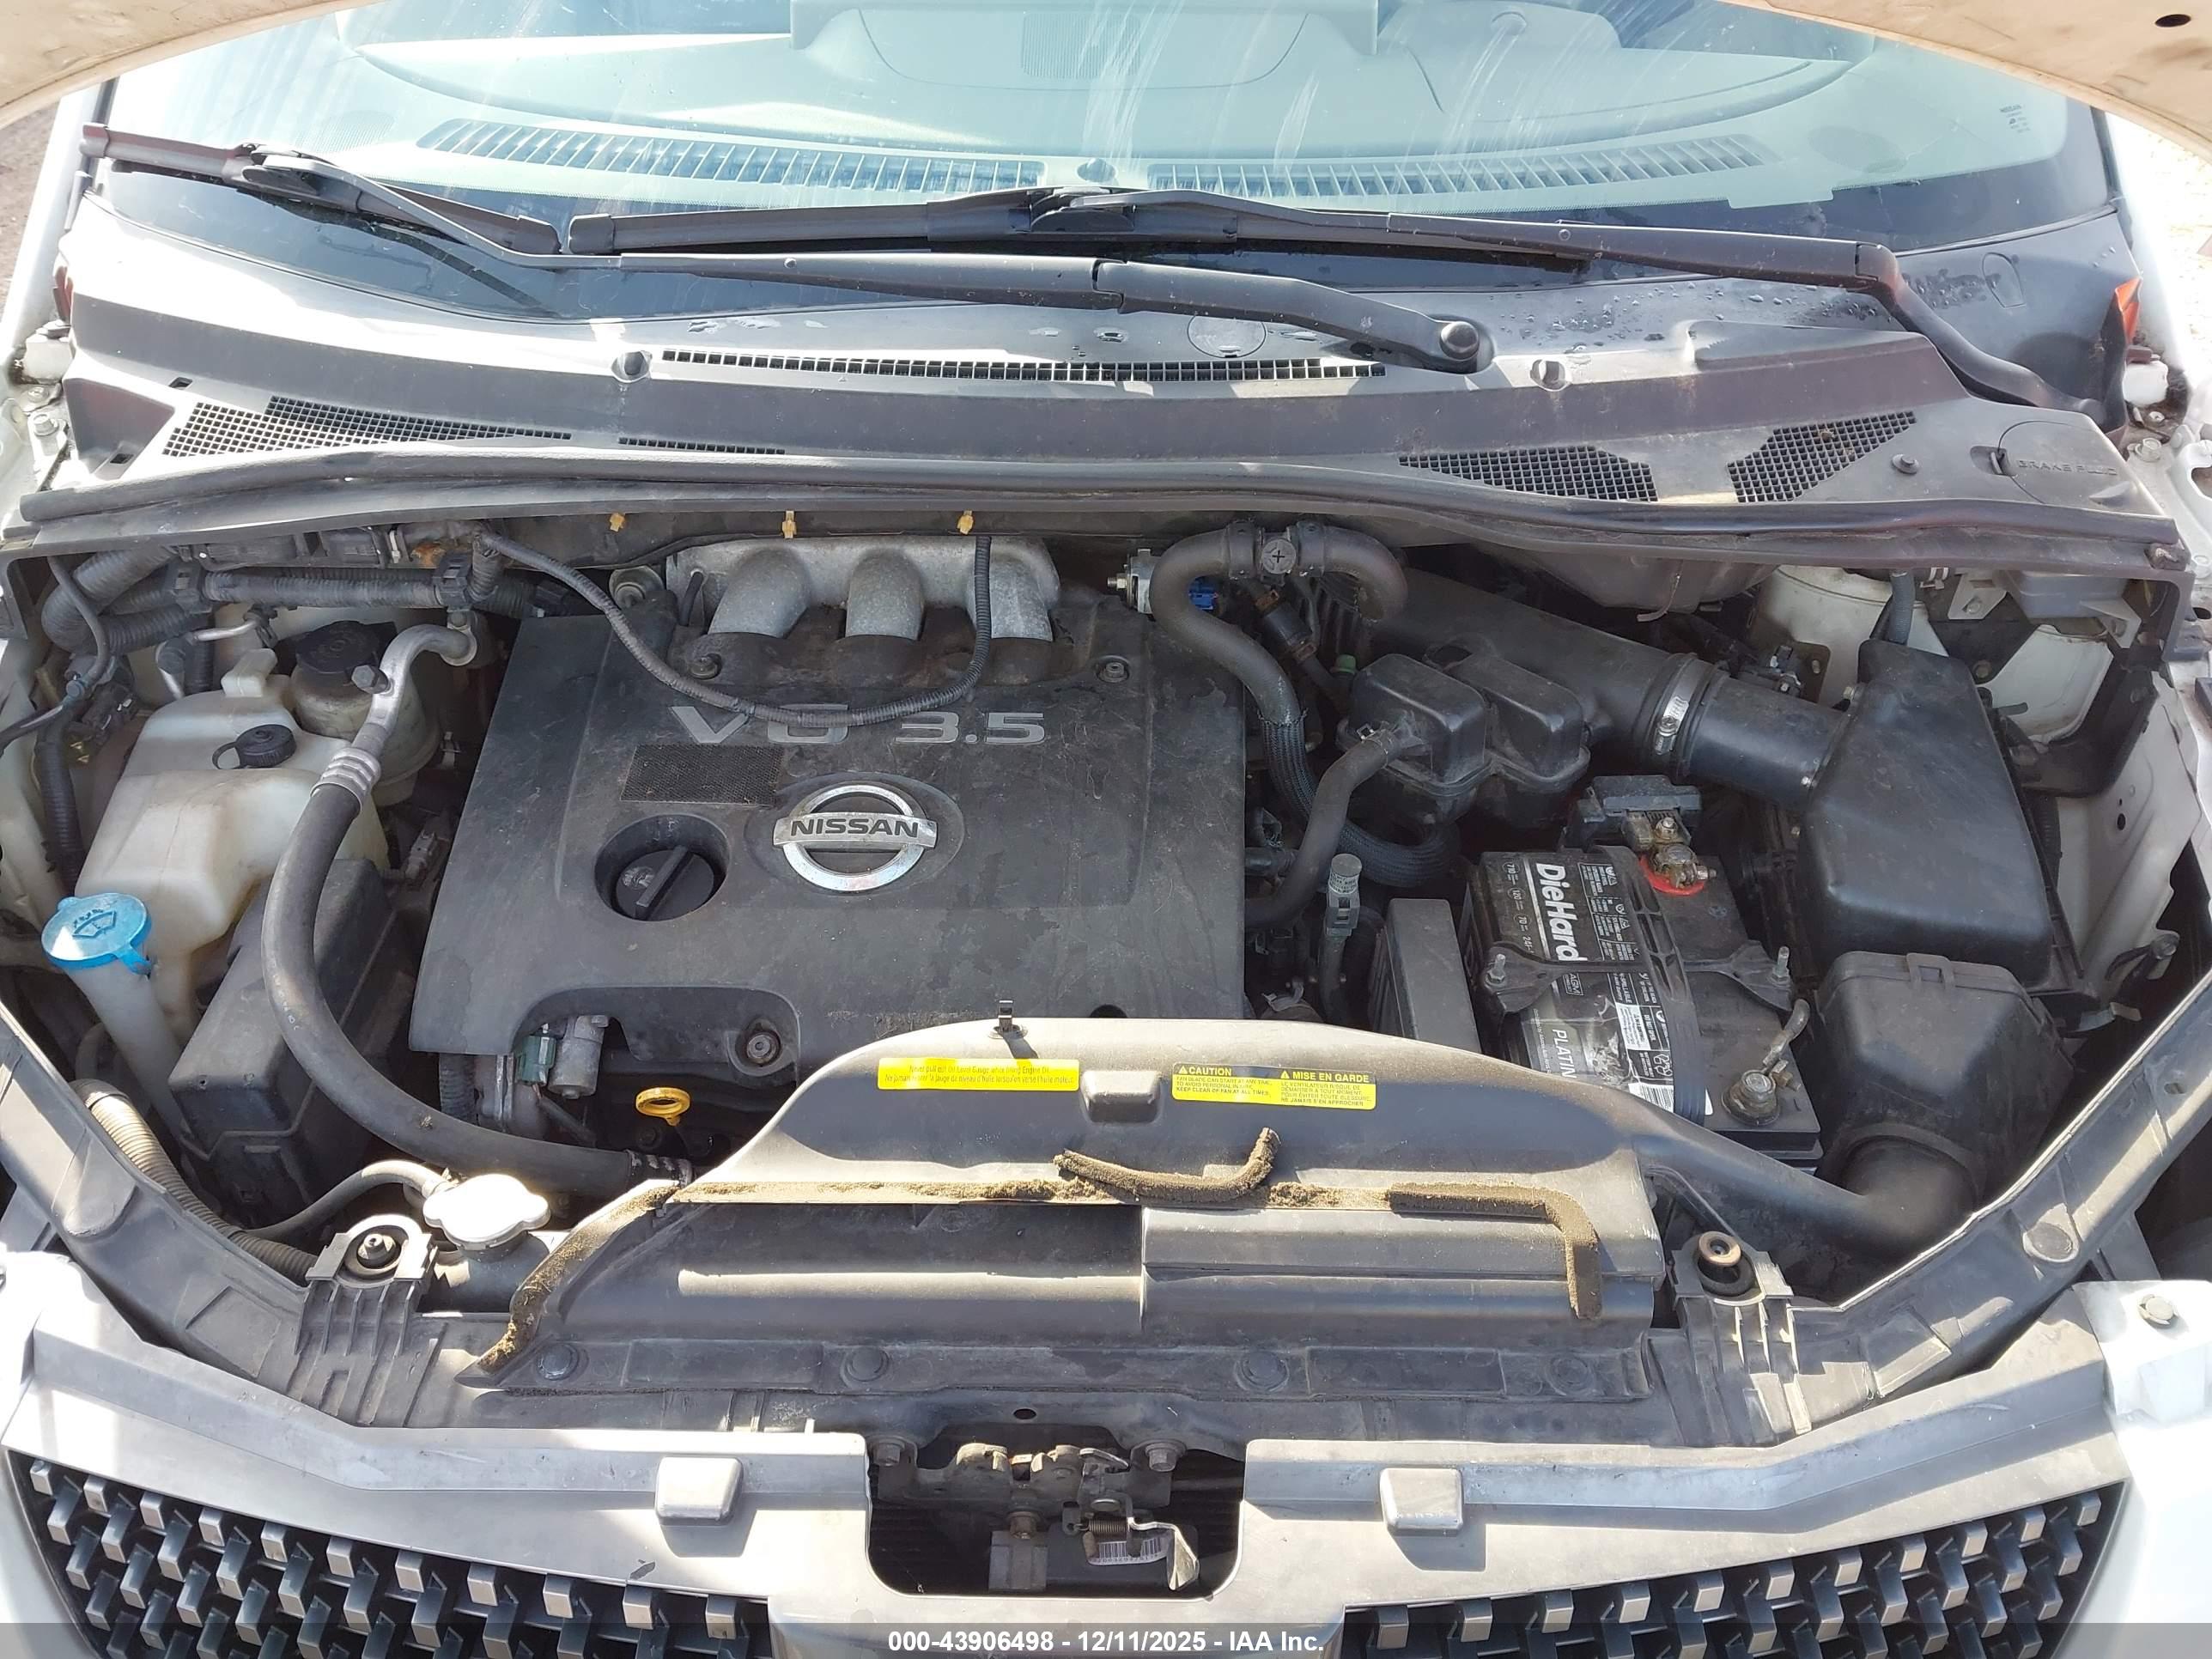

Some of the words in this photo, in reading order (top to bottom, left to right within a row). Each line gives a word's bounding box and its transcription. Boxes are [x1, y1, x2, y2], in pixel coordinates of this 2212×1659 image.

[2017, 459, 2072, 471] BRAKE
[894, 711, 1045, 744] 3.5
[790, 818, 919, 838] NISSAN
[1506, 864, 1516, 874] 710
[1512, 890, 1522, 900] 120
[1535, 862, 1589, 962] DieHard
[1518, 915, 1528, 924] 70
[1569, 973, 1582, 994] AGM
[1022, 1066, 1041, 1075] Engine
[1188, 1066, 1231, 1077] CAUTION
[1292, 1071, 1316, 1080] MISE
[1319, 1073, 1332, 1081] EN
[1334, 1073, 1370, 1083] GARDE
